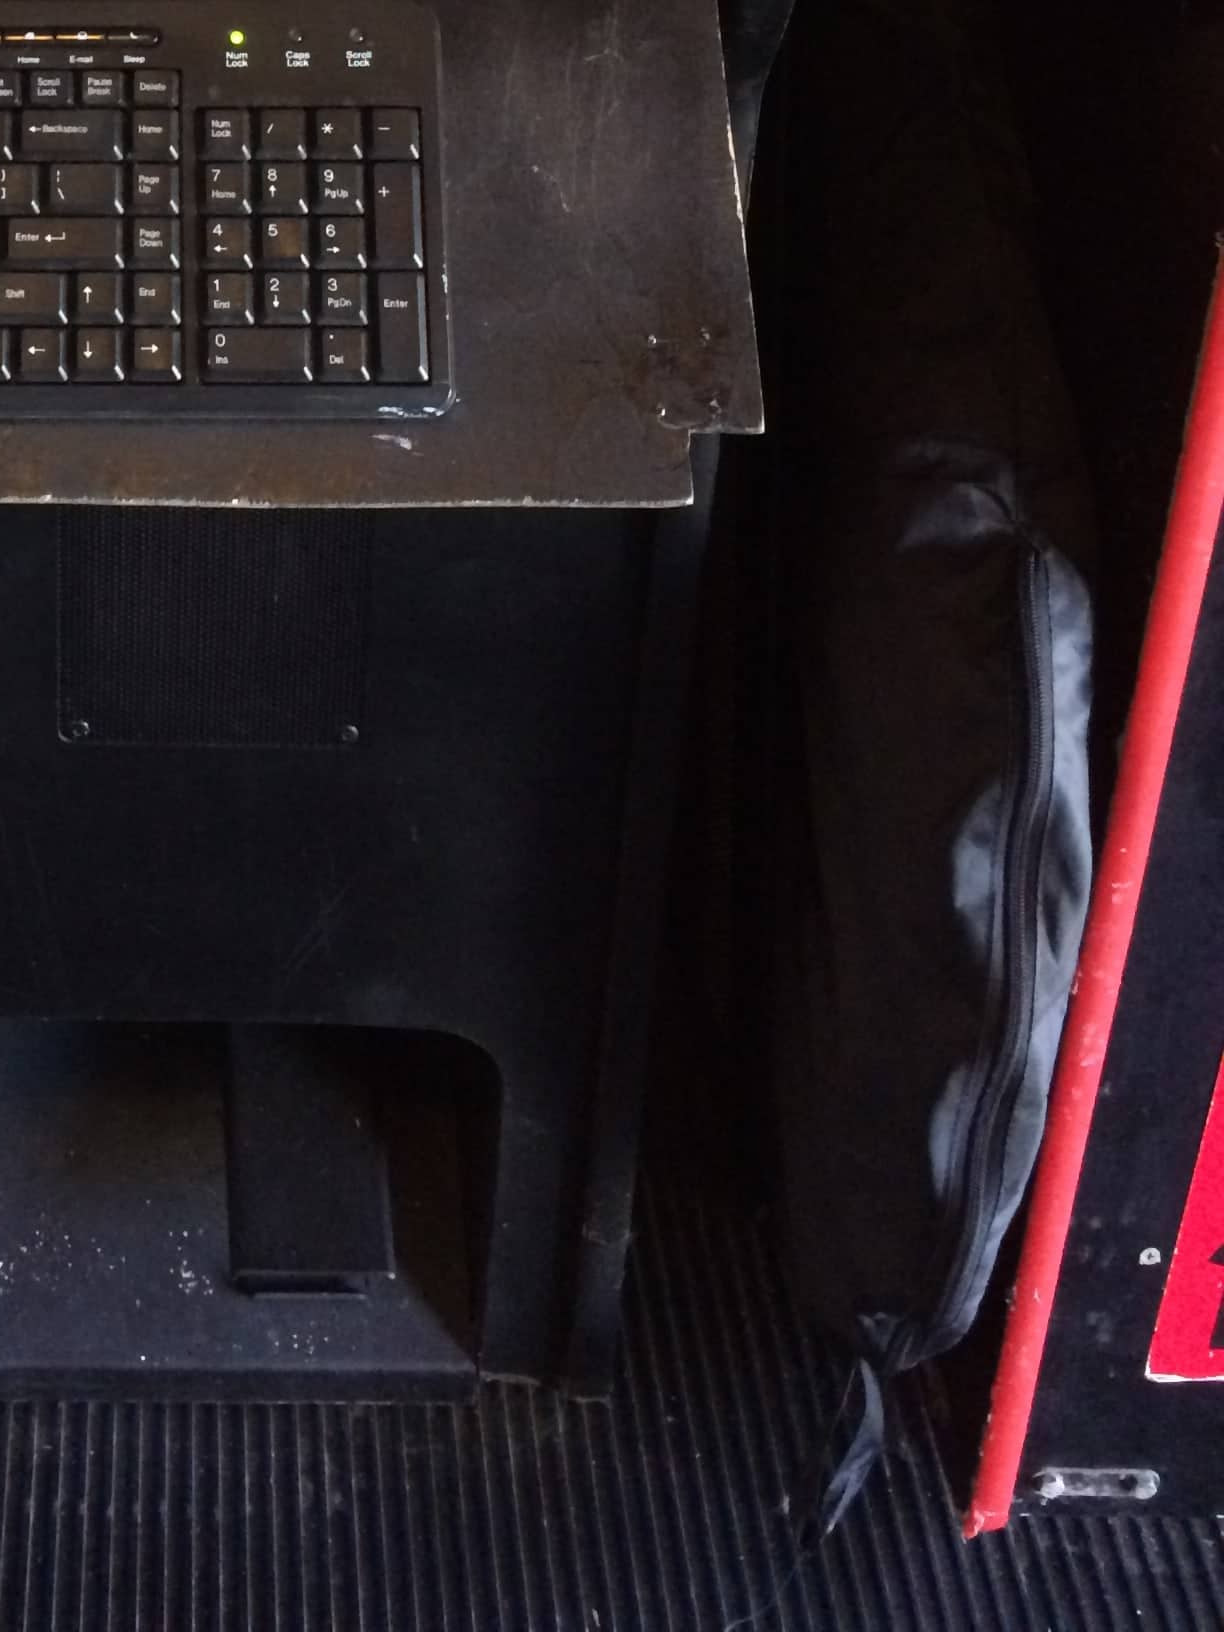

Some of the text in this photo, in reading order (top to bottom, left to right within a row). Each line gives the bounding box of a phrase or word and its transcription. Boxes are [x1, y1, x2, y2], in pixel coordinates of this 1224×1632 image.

[226, 52, 248, 60] Num
[226, 59, 248, 68] Lock
[287, 59, 309, 68] Lock
[348, 59, 371, 67] Lock
[15, 232, 40, 242] Enter
[384, 300, 408, 308] Enter
